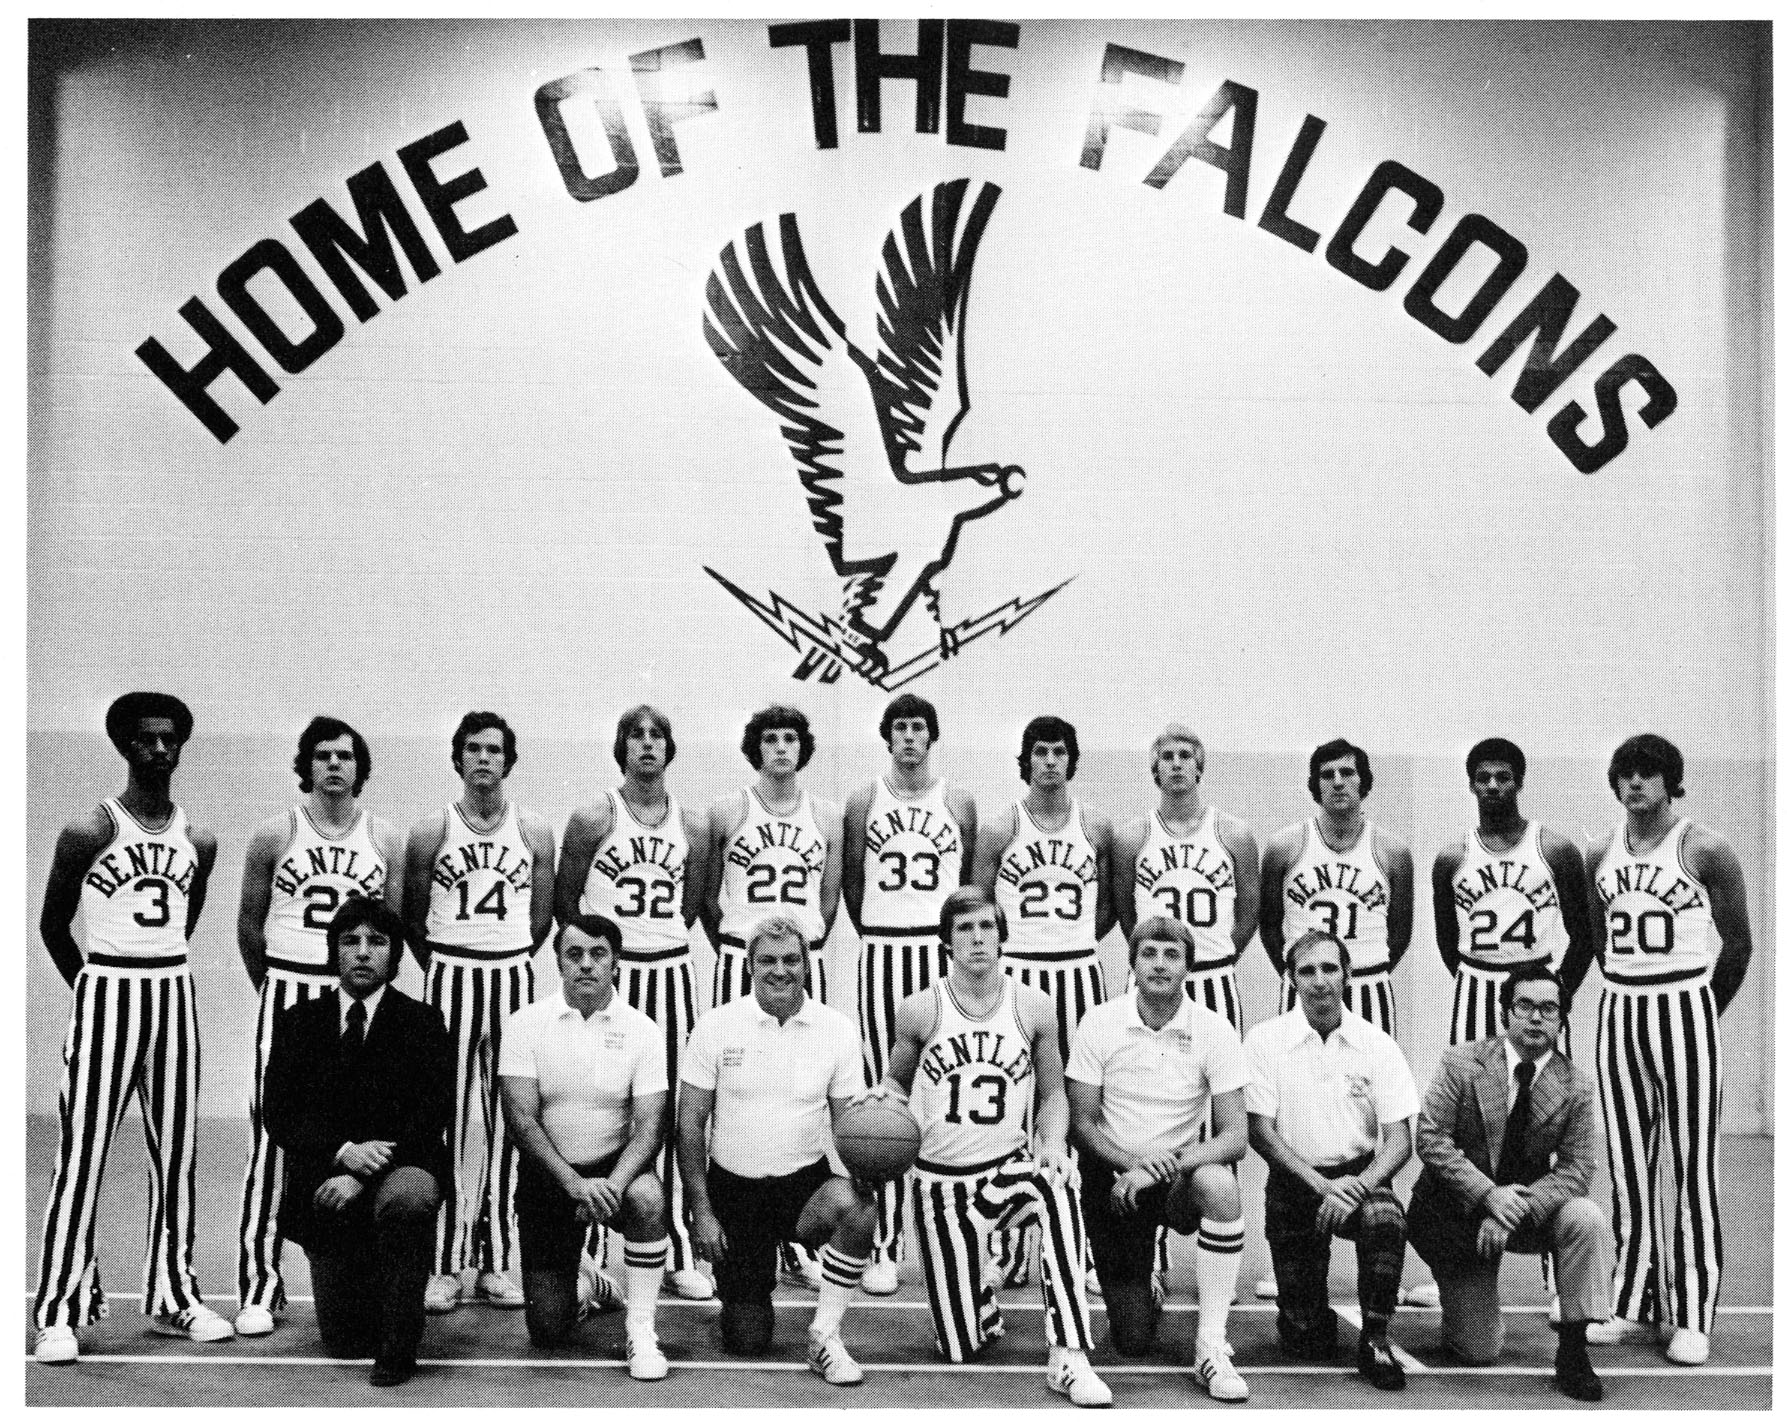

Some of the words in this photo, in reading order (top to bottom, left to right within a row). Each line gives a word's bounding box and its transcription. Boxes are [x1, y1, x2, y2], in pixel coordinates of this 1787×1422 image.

[134, 119, 519, 446] HOME
[534, 37, 719, 203] OF
[768, 18, 1021, 151] THE
[1079, 41, 1678, 476] FALCONS
[728, 822, 823, 873] BENTLEY
[866, 806, 957, 855] BENTLEY
[86, 842, 198, 899] BENTLE
[432, 842, 530, 893] BENTLEY
[746, 864, 807, 905] 22
[878, 851, 940, 892] 33
[1136, 844, 1235, 892] BENTLEY
[1287, 863, 1387, 911] BENTLEY
[1455, 861, 1558, 913] BENTLEY
[133, 877, 170, 927] 3
[303, 885, 360, 929] 2
[455, 880, 507, 921] 14
[614, 877, 675, 918] 32
[1019, 880, 1082, 920] 23
[1152, 887, 1217, 927] 30
[1309, 900, 1357, 940] 31
[1469, 909, 1537, 950] 24
[1611, 910, 1675, 955] 20
[922, 1031, 1032, 1086] BENTLEY
[945, 1073, 1007, 1125] 13
